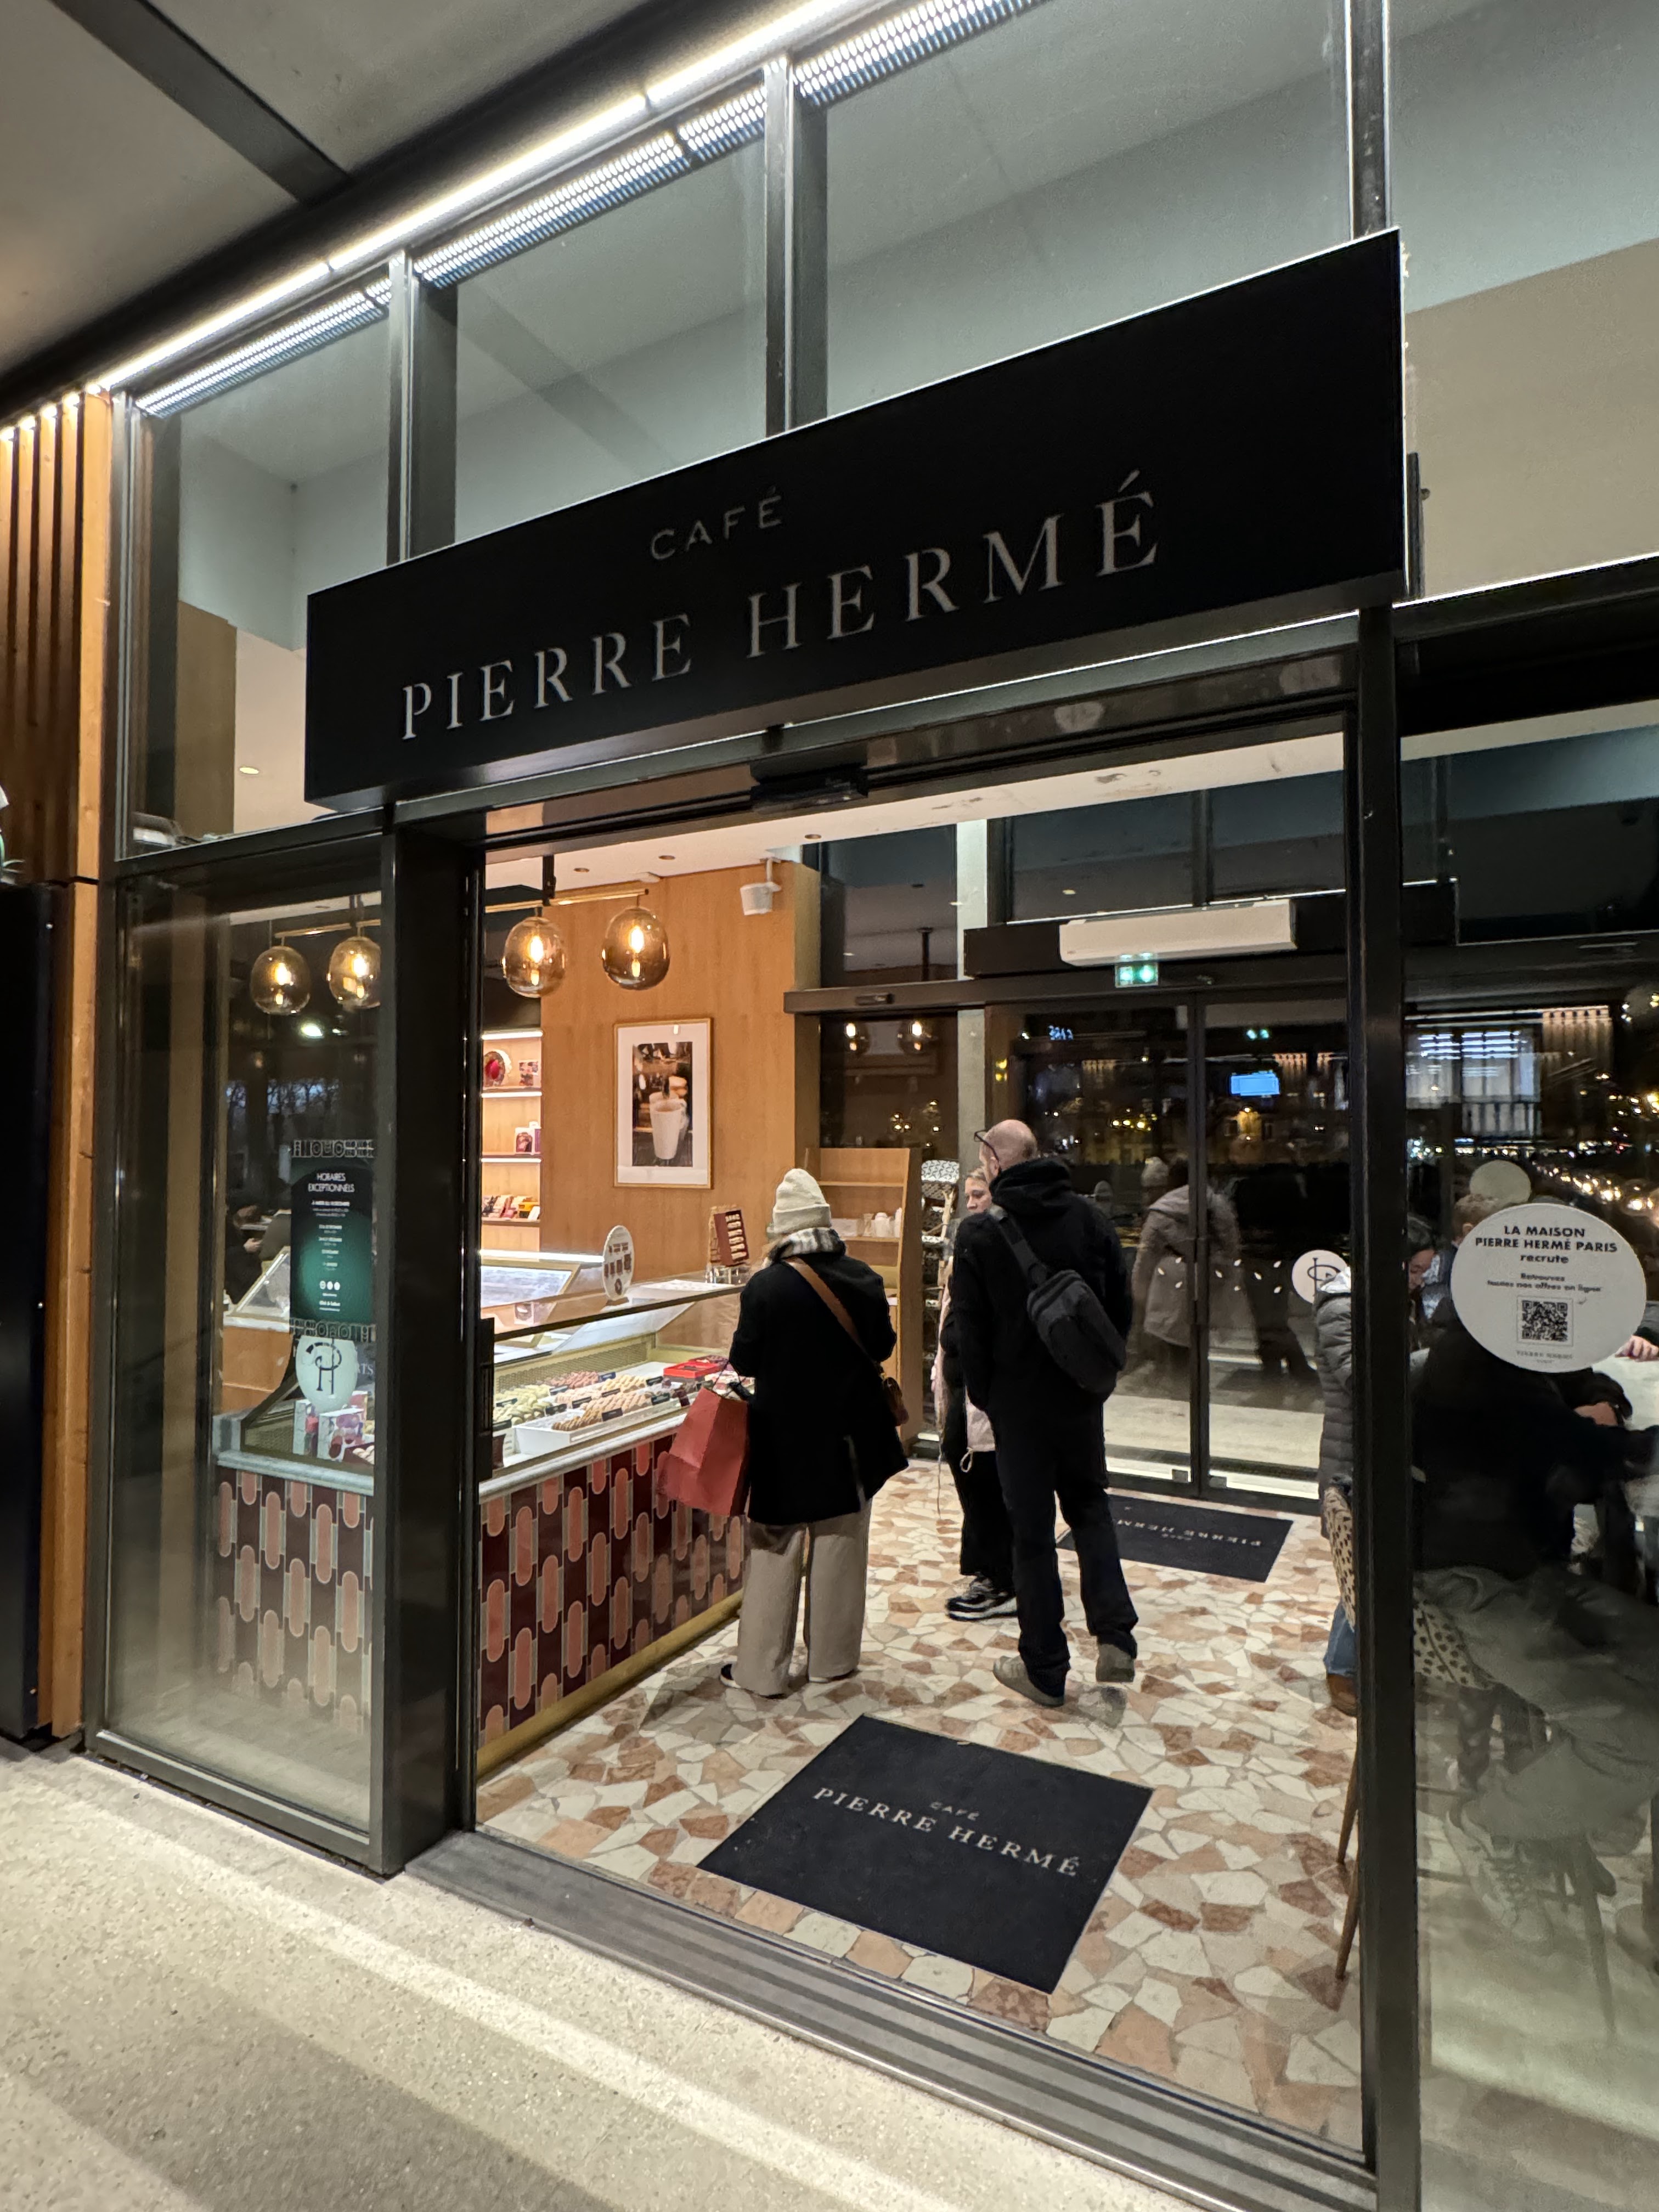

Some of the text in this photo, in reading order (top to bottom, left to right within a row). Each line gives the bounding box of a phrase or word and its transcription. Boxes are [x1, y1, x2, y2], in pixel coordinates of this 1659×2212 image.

[651, 486, 783, 560] CAFÉ
[402, 469, 1158, 740] PIERRE HERMÉ
[1504, 1226, 1585, 1237] LA MAISON
[1475, 1237, 1618, 1253] PIERRE HERMÉ PARIS
[1520, 1254, 1569, 1264] recrute
[929, 1801, 980, 1821] CAFÉ
[812, 1787, 1080, 1877] PIERRE HERMÉ
